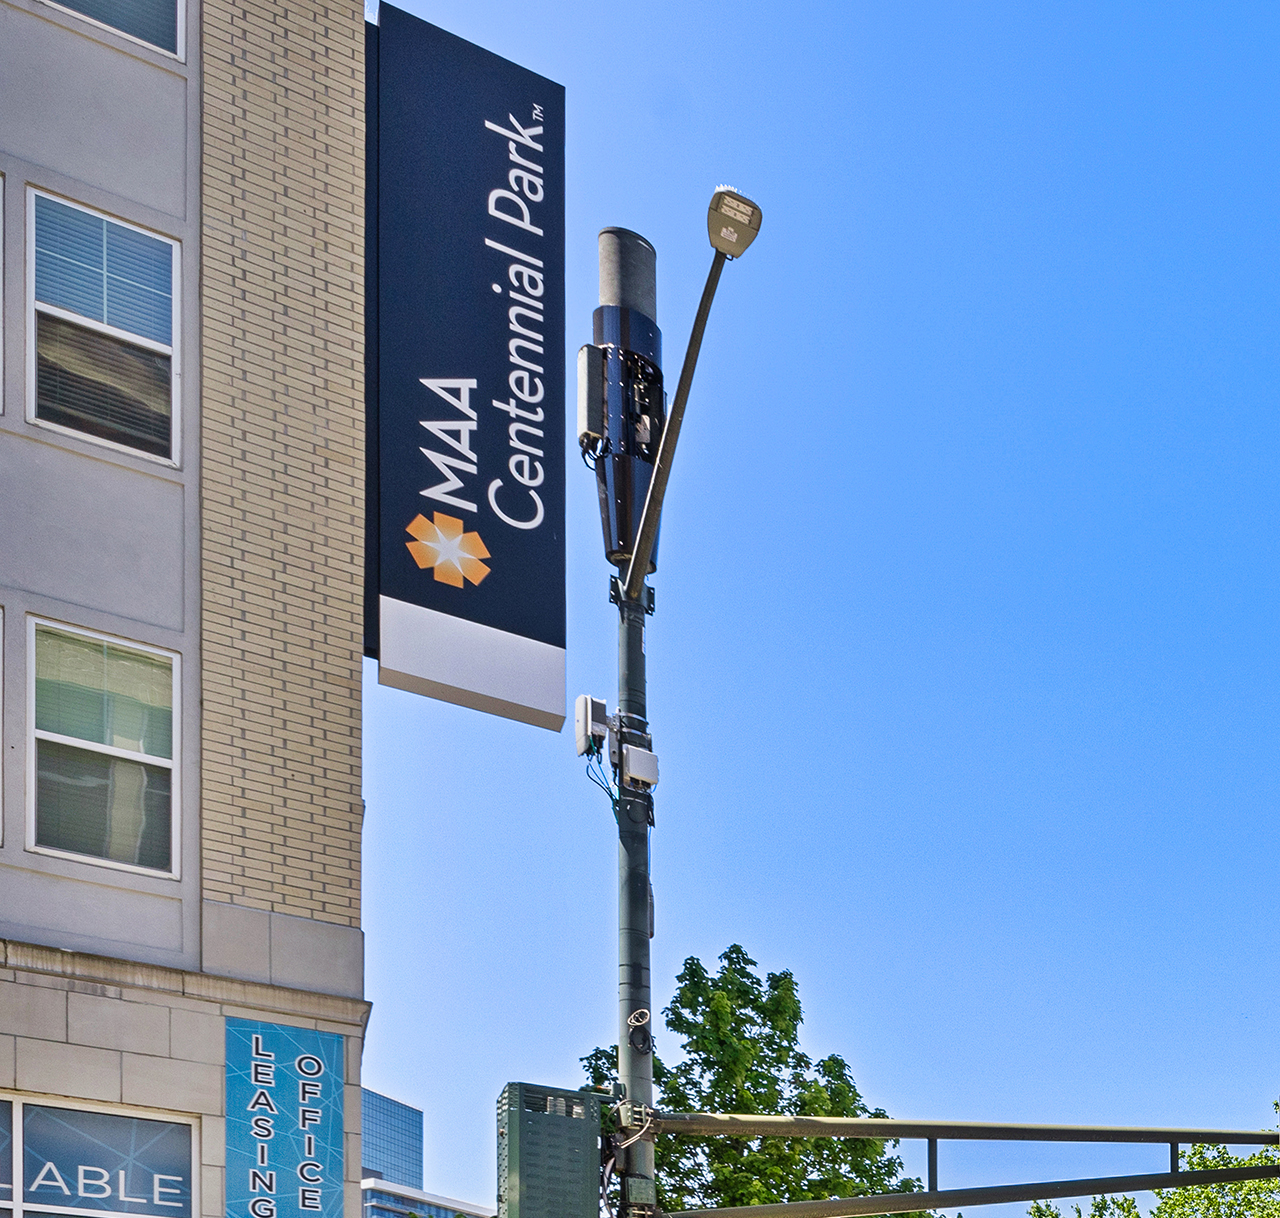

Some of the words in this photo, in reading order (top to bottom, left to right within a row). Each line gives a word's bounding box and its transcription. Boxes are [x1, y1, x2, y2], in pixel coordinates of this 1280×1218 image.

[418, 378, 478, 513] MAA
[484, 237, 545, 530] Centennial
[0, 1162, 183, 1207] ABLE
[294, 1053, 325, 1212] OFFICE
